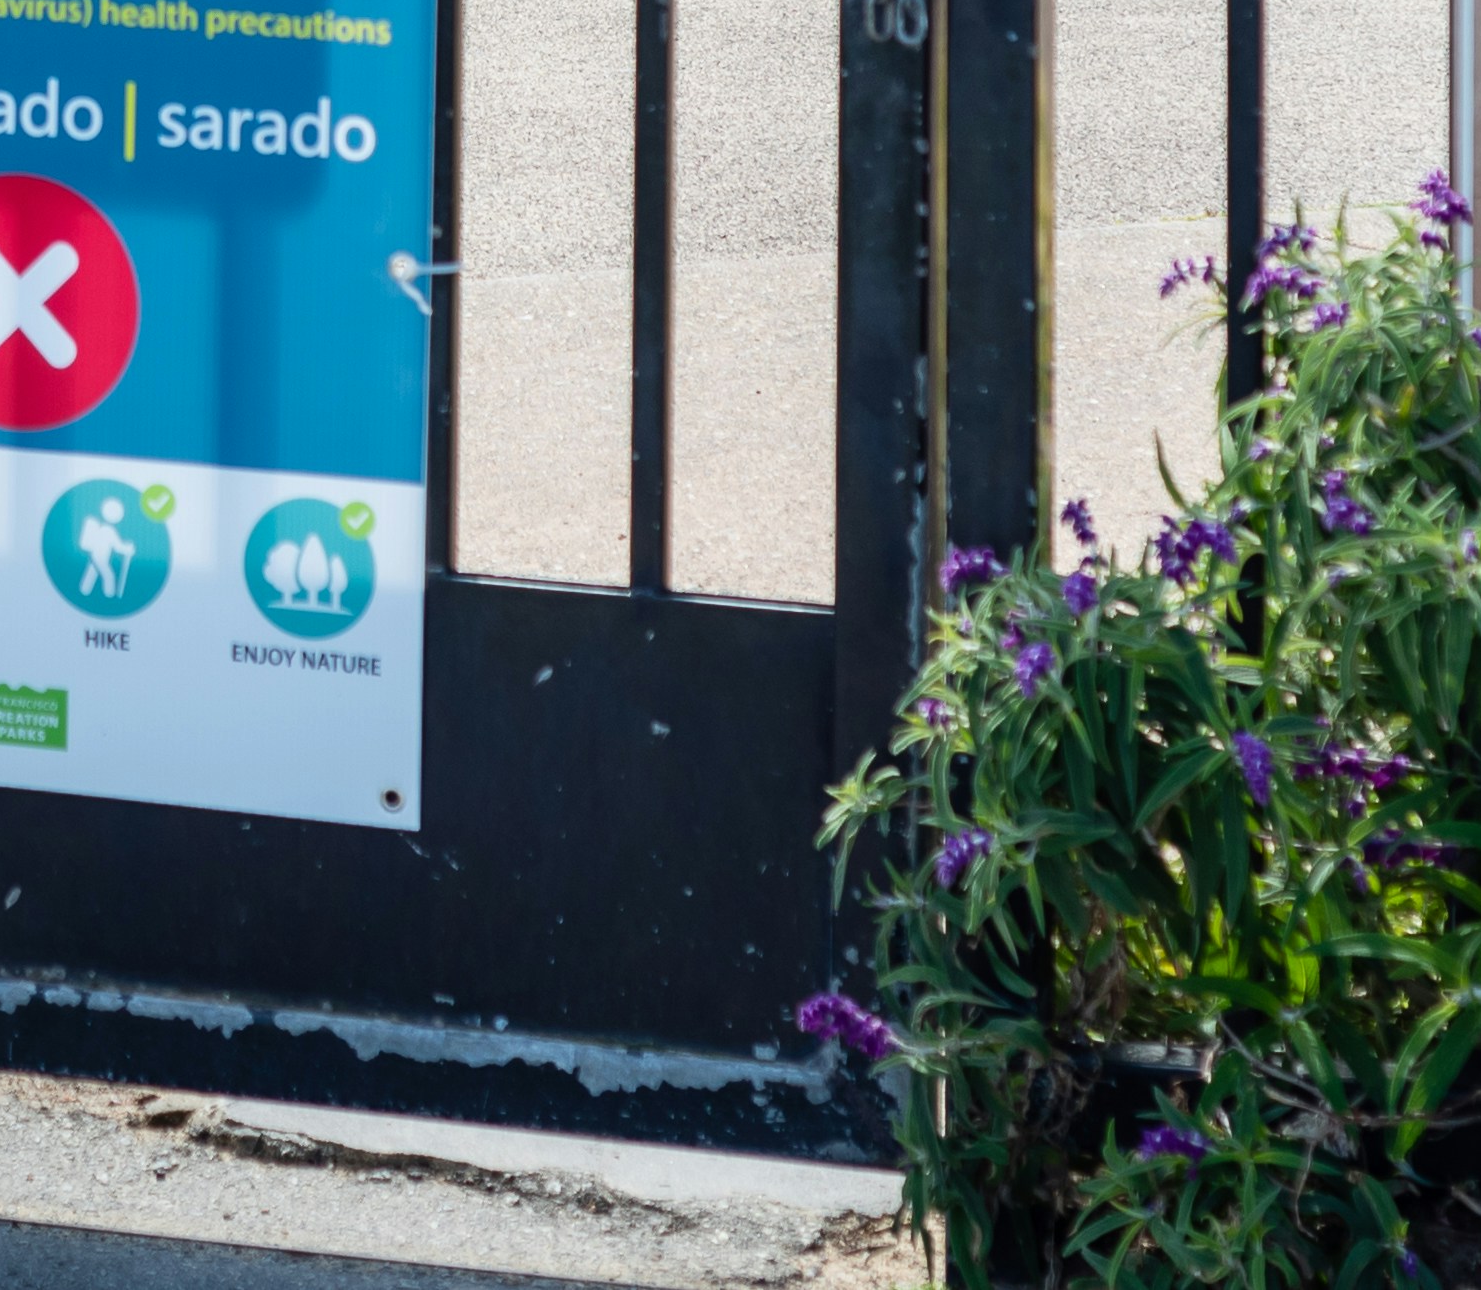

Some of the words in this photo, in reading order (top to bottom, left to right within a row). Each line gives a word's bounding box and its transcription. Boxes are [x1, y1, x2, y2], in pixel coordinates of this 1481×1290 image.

[204, 6, 392, 47] precautions
[156, 95, 378, 163] sarado
[83, 627, 132, 653] HIKE
[231, 642, 296, 673] ENJOY
[300, 649, 383, 678] NATURE
